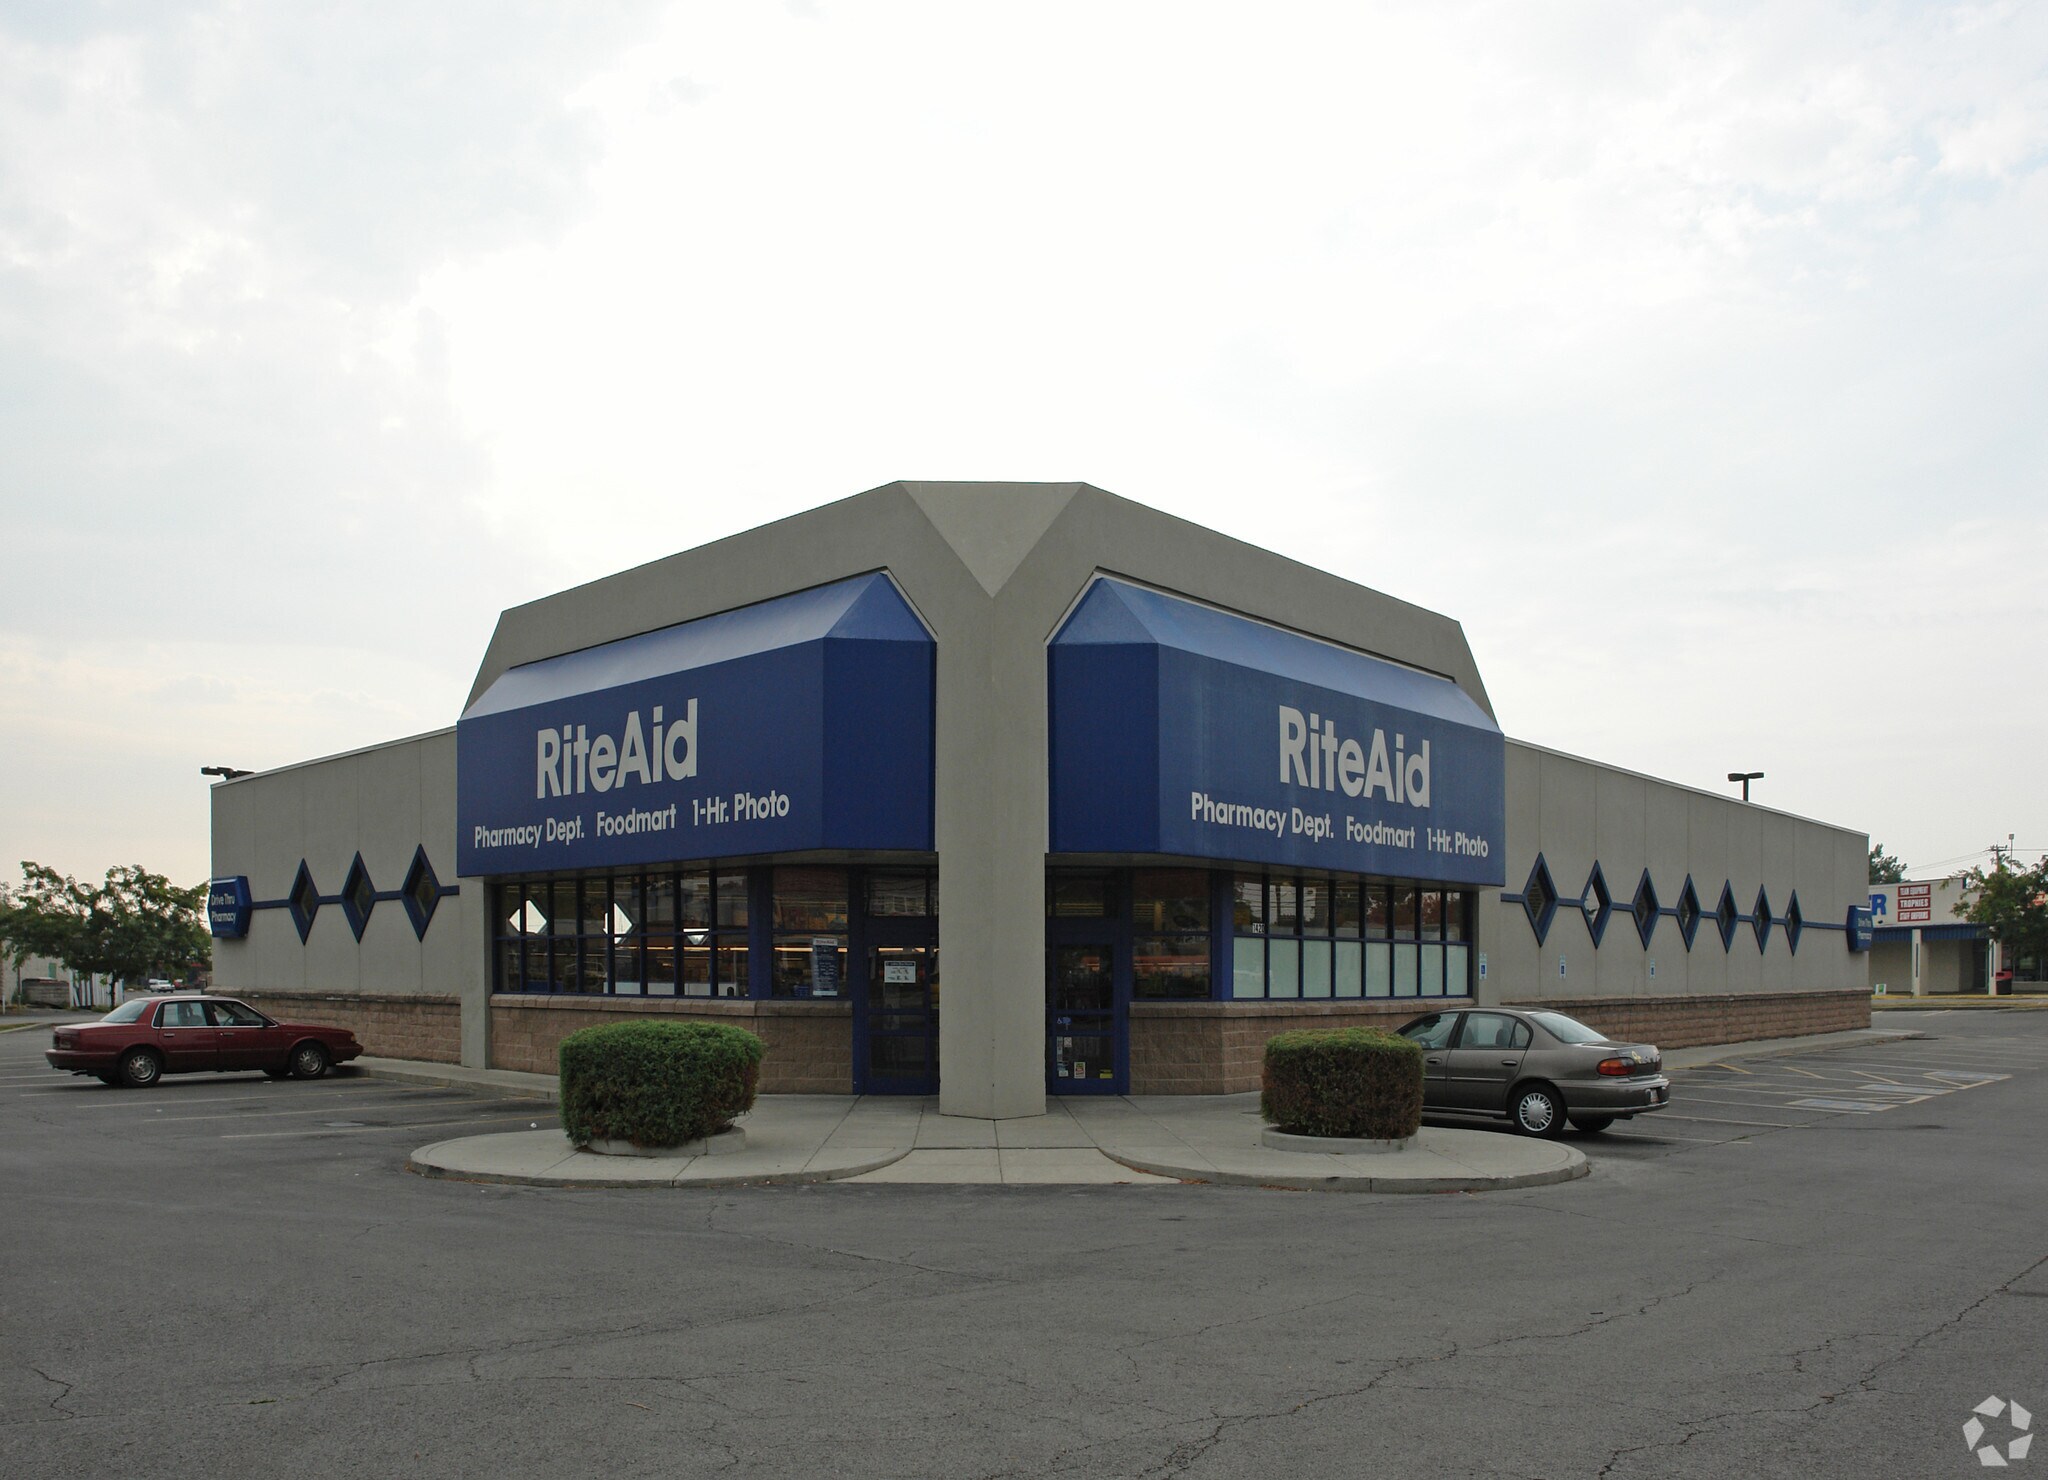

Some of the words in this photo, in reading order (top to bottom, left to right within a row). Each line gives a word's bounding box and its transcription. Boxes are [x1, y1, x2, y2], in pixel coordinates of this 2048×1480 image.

[537, 698, 698, 799] RiteAid
[1279, 705, 1430, 808] RiteAid
[474, 825, 542, 849] Pharmacy
[546, 815, 585, 846] Dept.
[597, 803, 677, 837] Foodmart
[692, 796, 729, 826] 1-Hr.
[734, 789, 790, 821] Photo
[1191, 791, 1287, 838] Pharmacy
[1291, 807, 1334, 843] Dept.
[1346, 815, 1416, 849] Foodmart
[1426, 827, 1452, 853] 1-Hr.
[1455, 831, 1489, 858] Photo
[211, 894, 224, 906] Drive
[224, 892, 235, 905] Thru
[211, 911, 236, 924] Pharmacy
[1900, 898, 1929, 908] TROPHIES
